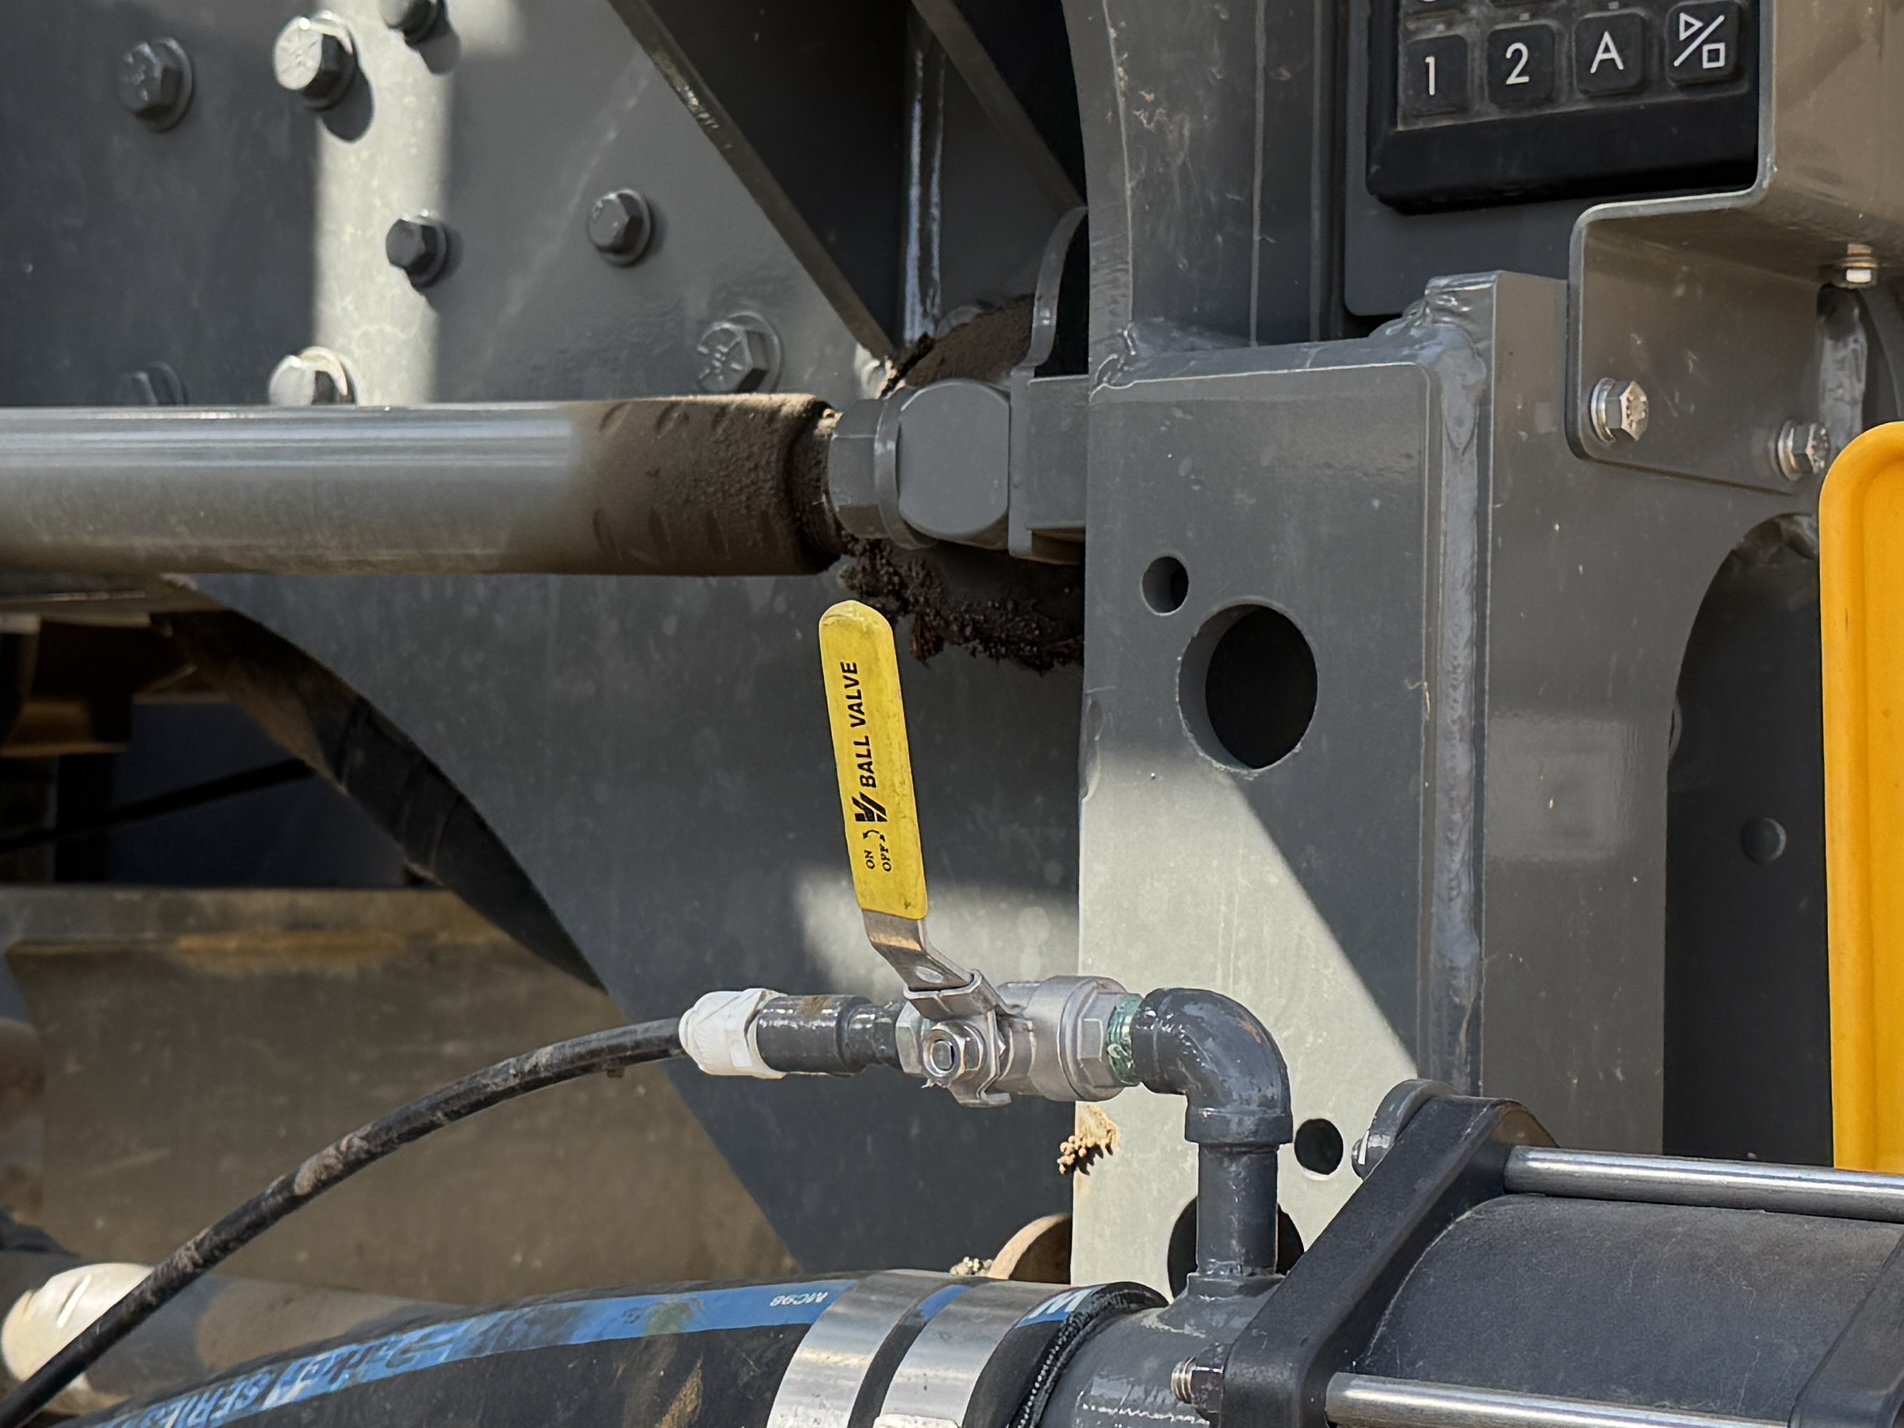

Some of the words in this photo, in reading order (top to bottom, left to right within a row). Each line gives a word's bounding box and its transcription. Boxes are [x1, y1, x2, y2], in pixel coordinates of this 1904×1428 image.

[1425, 55, 1437, 96] 1
[1505, 42, 1530, 85] 2
[1589, 31, 1625, 74] A
[840, 661, 867, 729] VALVE
[851, 735, 877, 789] BALL
[865, 849, 876, 870] ON
